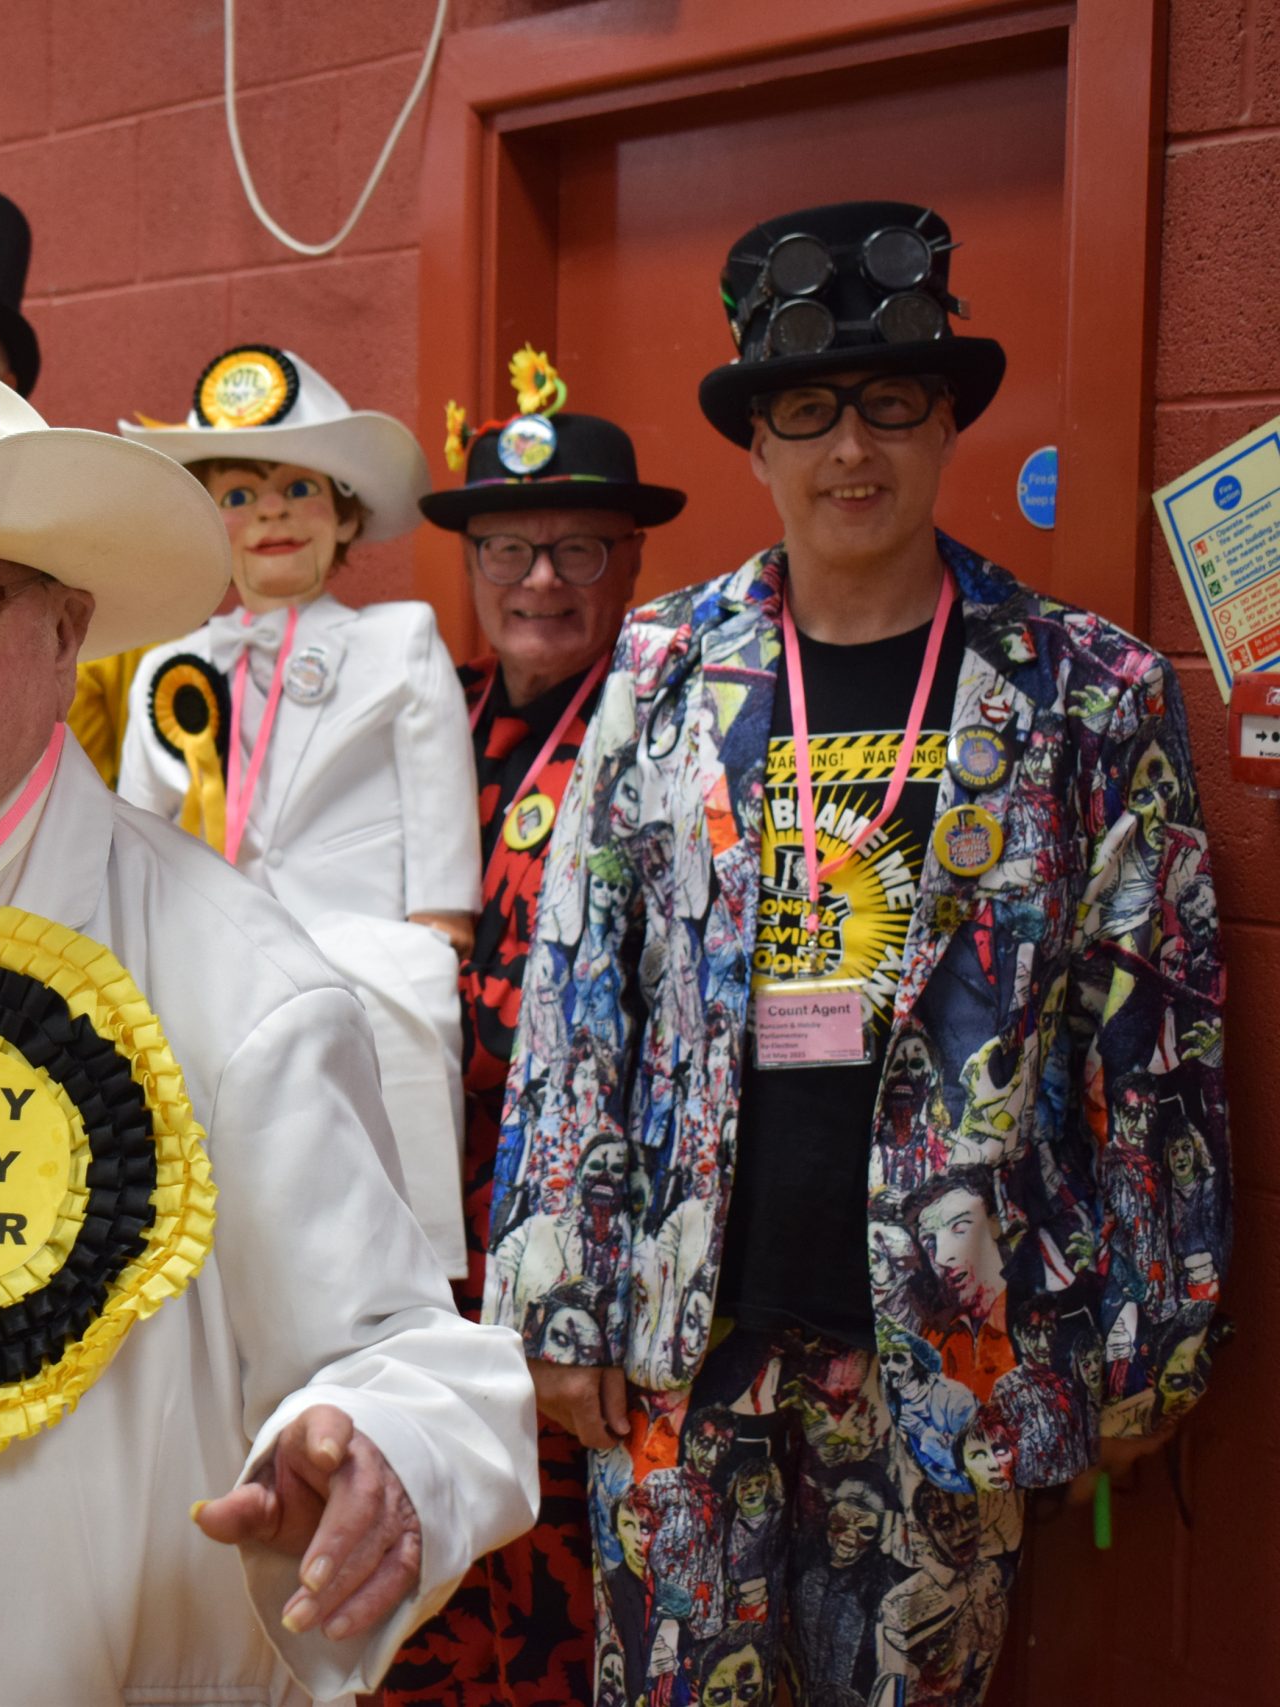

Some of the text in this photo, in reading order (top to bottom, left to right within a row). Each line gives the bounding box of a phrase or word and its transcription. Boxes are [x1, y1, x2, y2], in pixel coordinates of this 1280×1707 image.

[767, 749, 944, 770] WARING! WARING!
[875, 850, 918, 911] ME
[759, 898, 837, 928] ONSTR
[757, 925, 836, 949] AVIG
[767, 1003, 851, 1017] Count Agent
